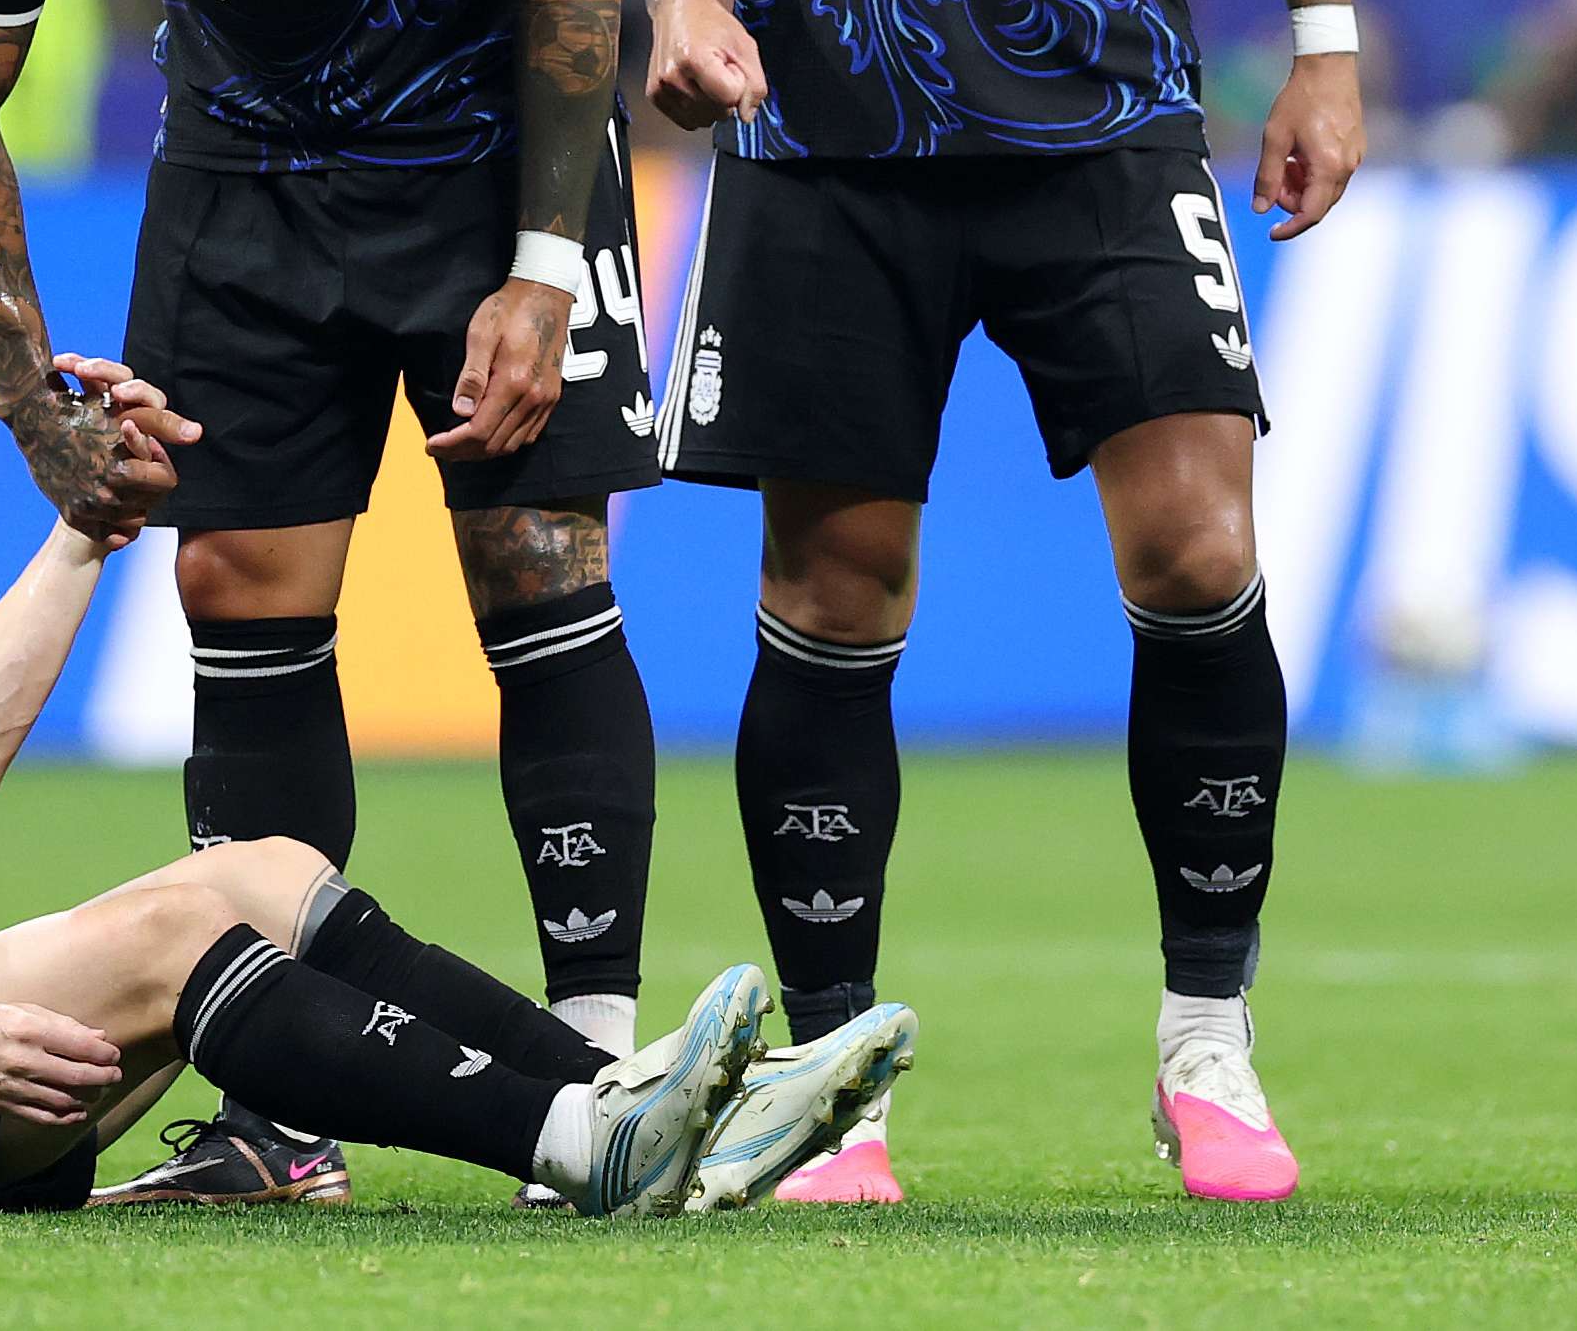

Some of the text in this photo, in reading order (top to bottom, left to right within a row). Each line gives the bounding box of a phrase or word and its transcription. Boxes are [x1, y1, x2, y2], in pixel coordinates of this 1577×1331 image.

[1170, 193, 1240, 312] 5
[561, 245, 648, 382] 24
[1185, 774, 1265, 818] AFA
[537, 822, 606, 868] AFA
[774, 803, 859, 842] AFA
